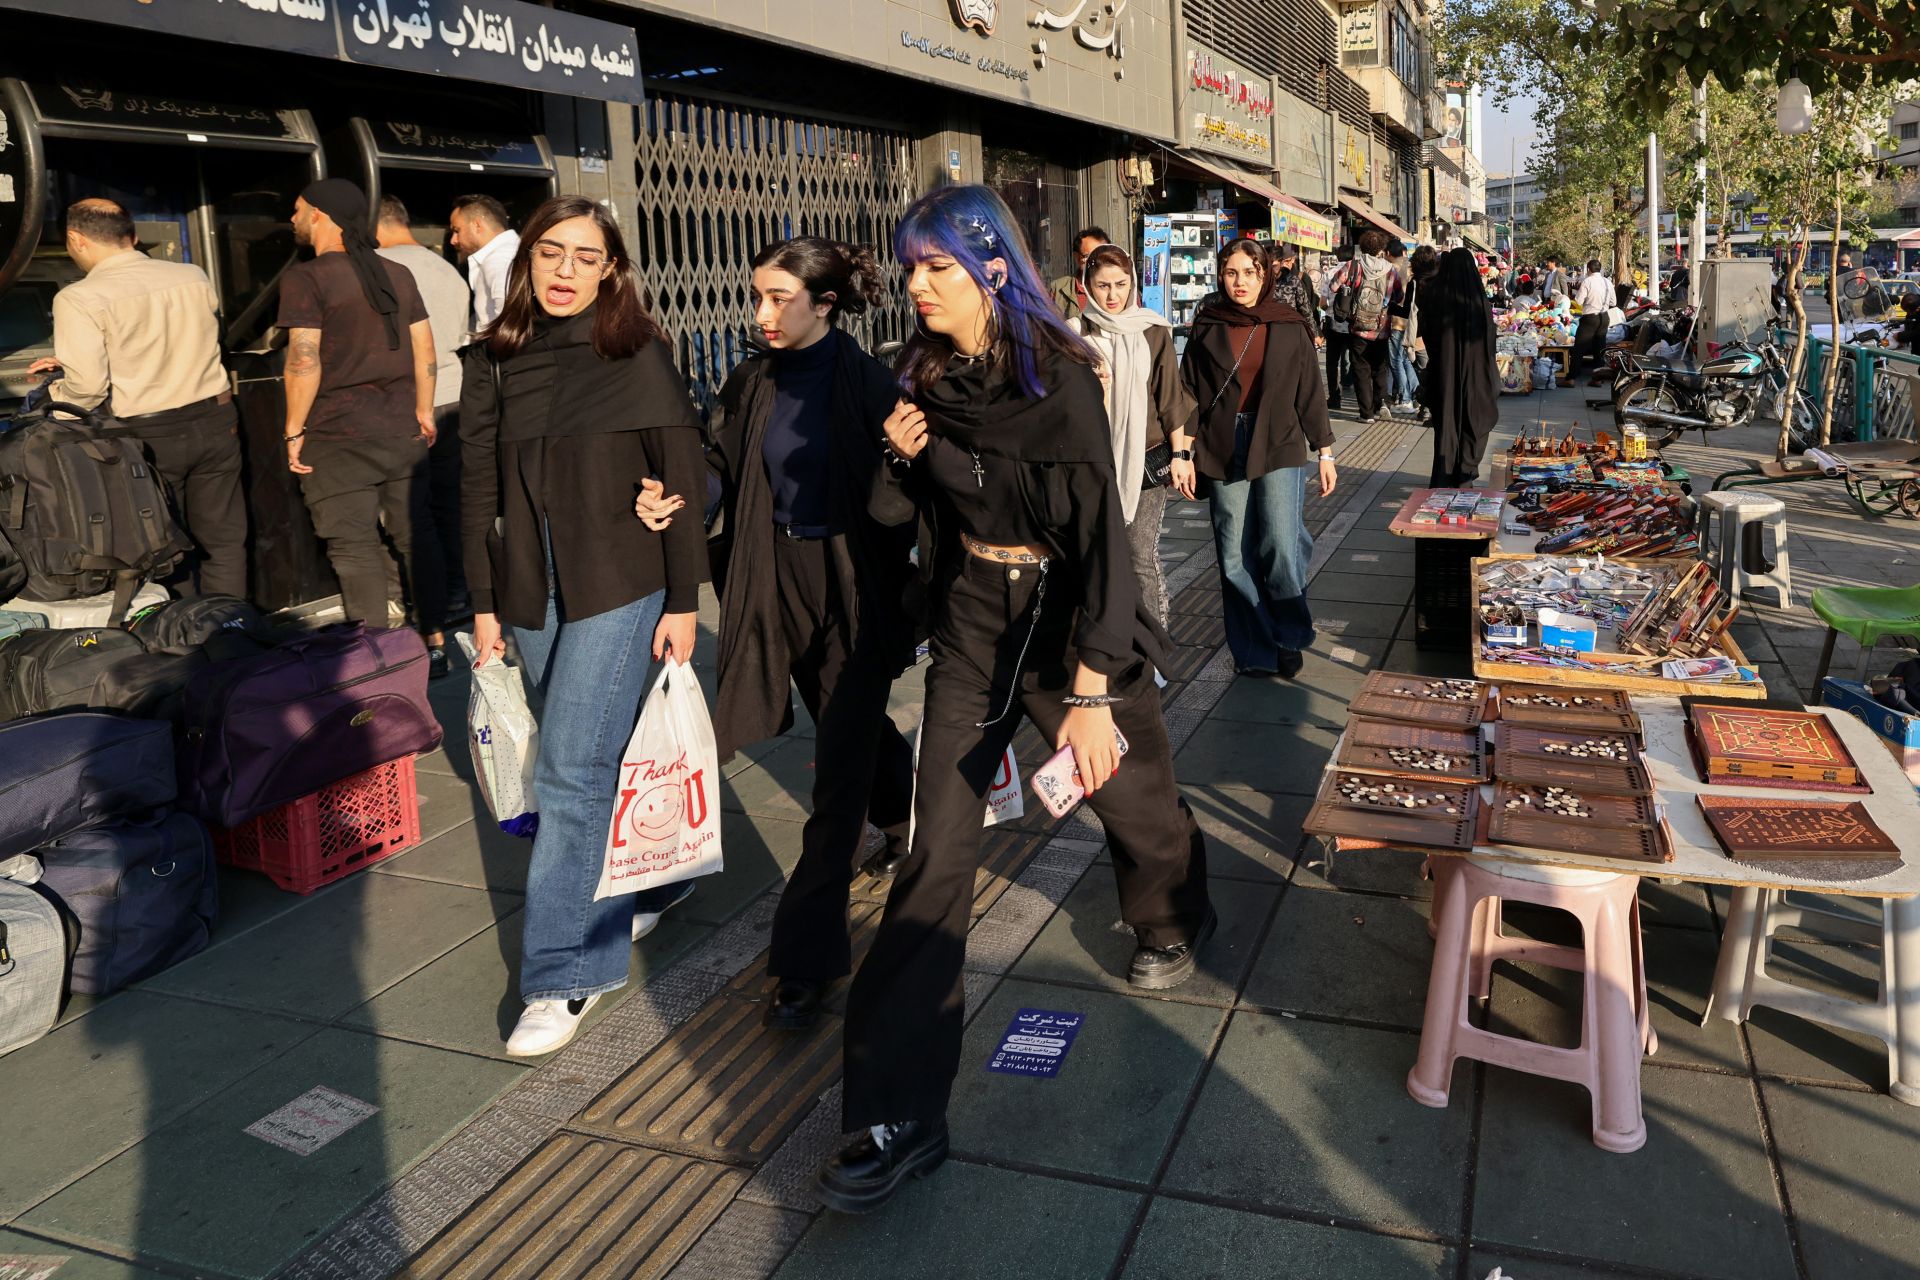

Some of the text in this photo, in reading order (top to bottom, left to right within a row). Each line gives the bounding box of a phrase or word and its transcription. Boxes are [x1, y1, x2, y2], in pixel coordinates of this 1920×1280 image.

[353, 0, 432, 49] تهران
[439, 5, 515, 57] انقلاب
[522, 24, 586, 76] میدان
[590, 43, 635, 82] شعبه
[624, 751, 689, 786] Thank
[1019, 1014, 1079, 1028] ثبت شرکت
